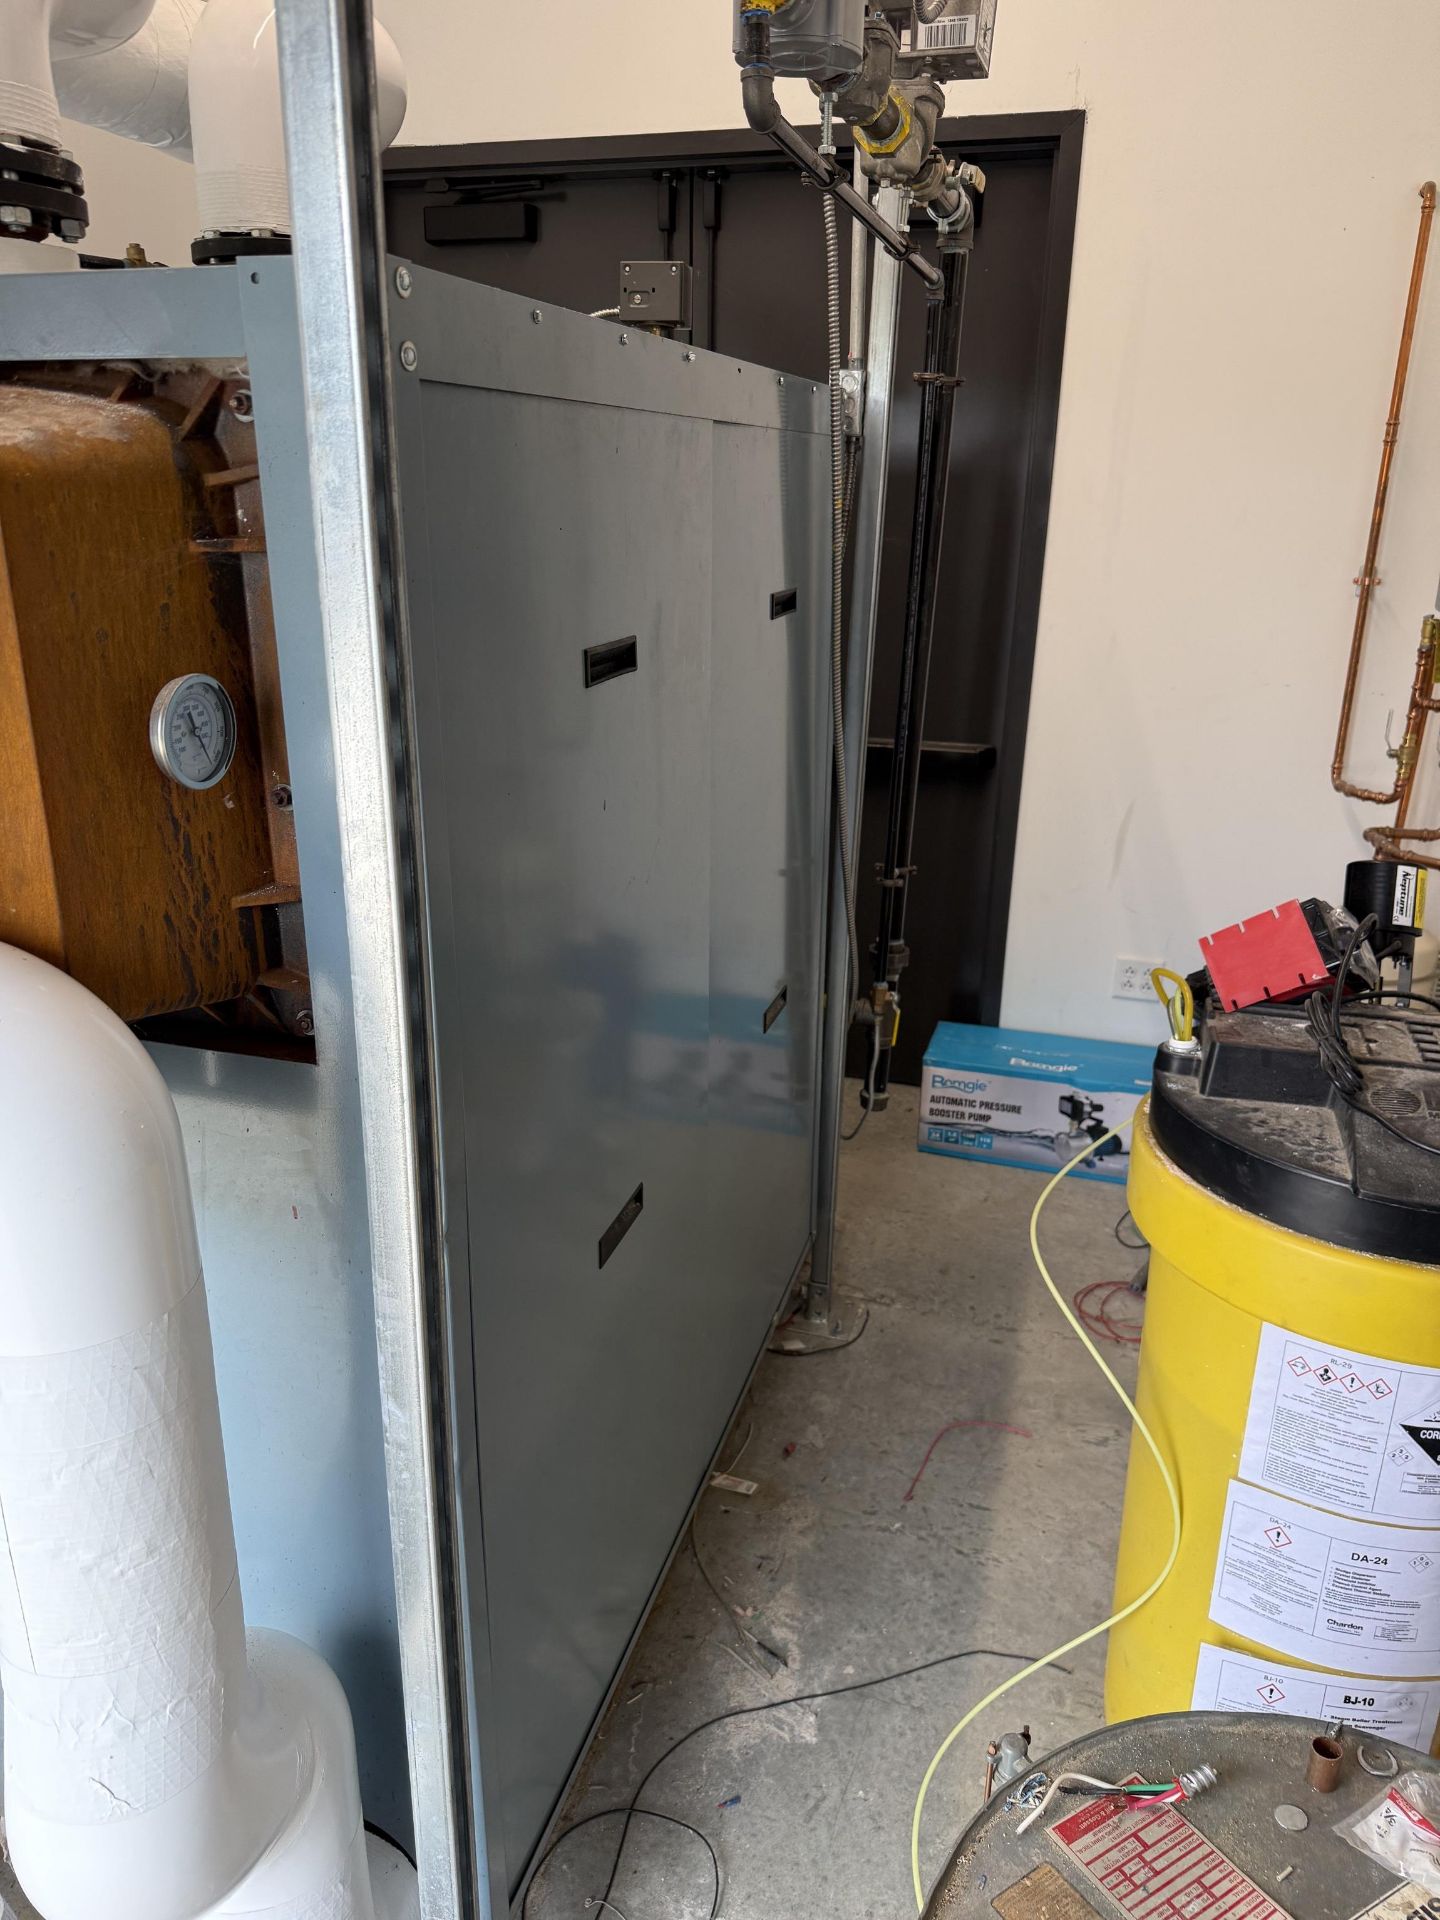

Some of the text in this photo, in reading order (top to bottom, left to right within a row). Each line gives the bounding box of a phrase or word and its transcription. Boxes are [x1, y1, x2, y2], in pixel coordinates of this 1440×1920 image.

[1399, 871, 1412, 916] Neptune
[929, 1094, 1022, 1115] AUTOMATIC PRESSURE
[928, 1108, 992, 1123] BOOSTER PUMP
[1330, 1358, 1353, 1370] RL-29
[1420, 1429, 1440, 1440] COR
[1351, 1552, 1389, 1566] DA-24
[1327, 1618, 1364, 1631] Chardon
[1343, 1695, 1375, 1707] BJ-10
